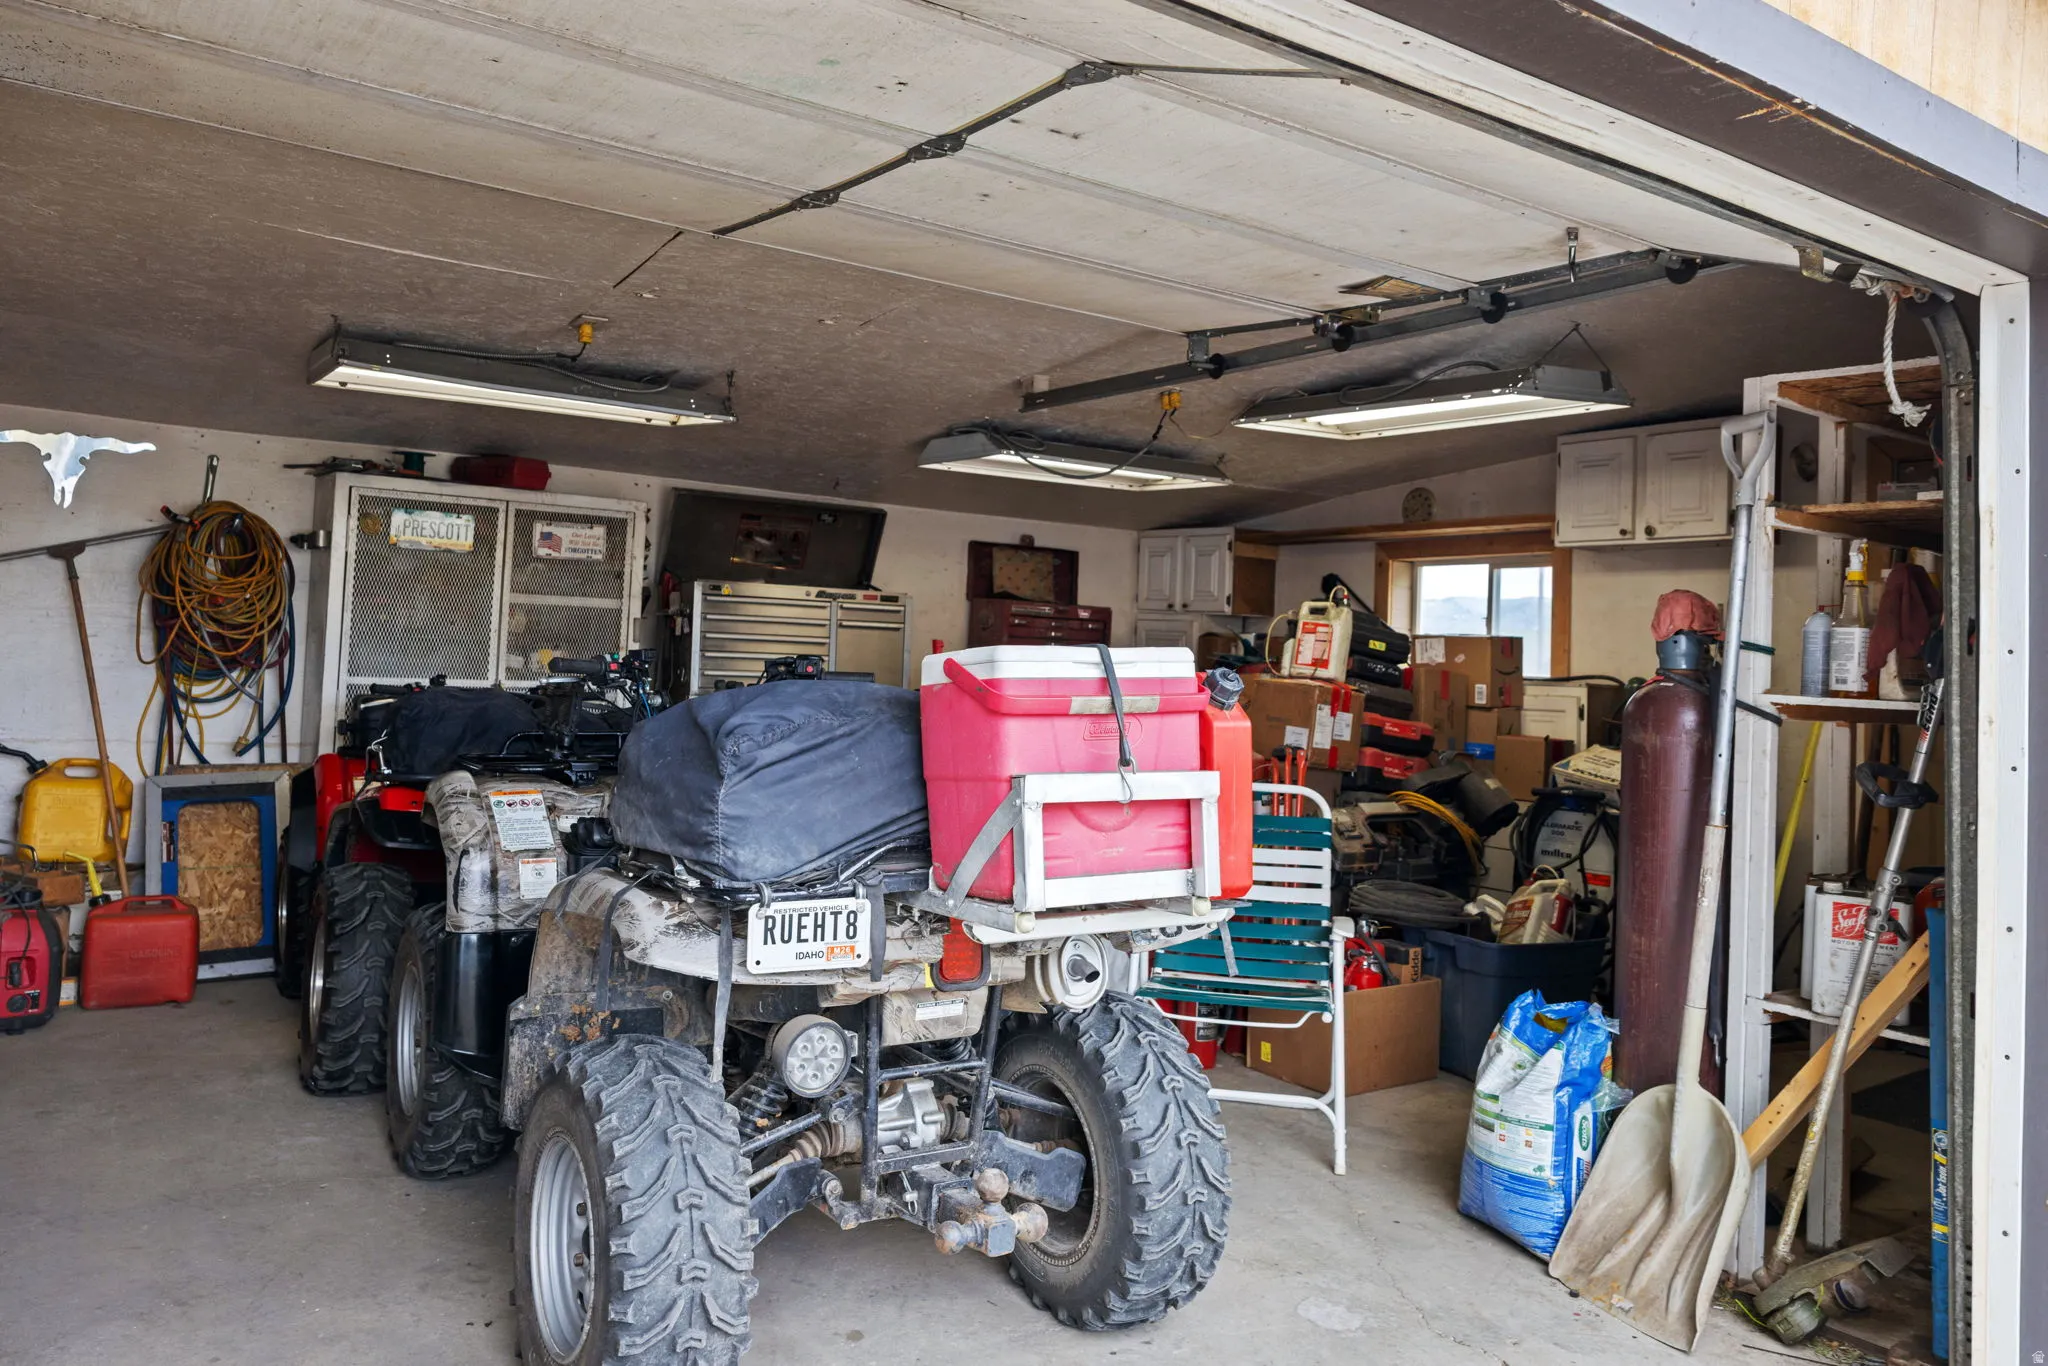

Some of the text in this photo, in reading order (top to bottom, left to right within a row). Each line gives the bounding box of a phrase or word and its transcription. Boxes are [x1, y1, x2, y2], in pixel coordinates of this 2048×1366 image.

[402, 518, 472, 542] PRESCOTT
[773, 904, 849, 915] RESTRICTED VEHICLE
[763, 910, 858, 946] RUEHT8
[795, 950, 825, 960] IDAHO
[1581, 1119, 1590, 1148] Scotts
